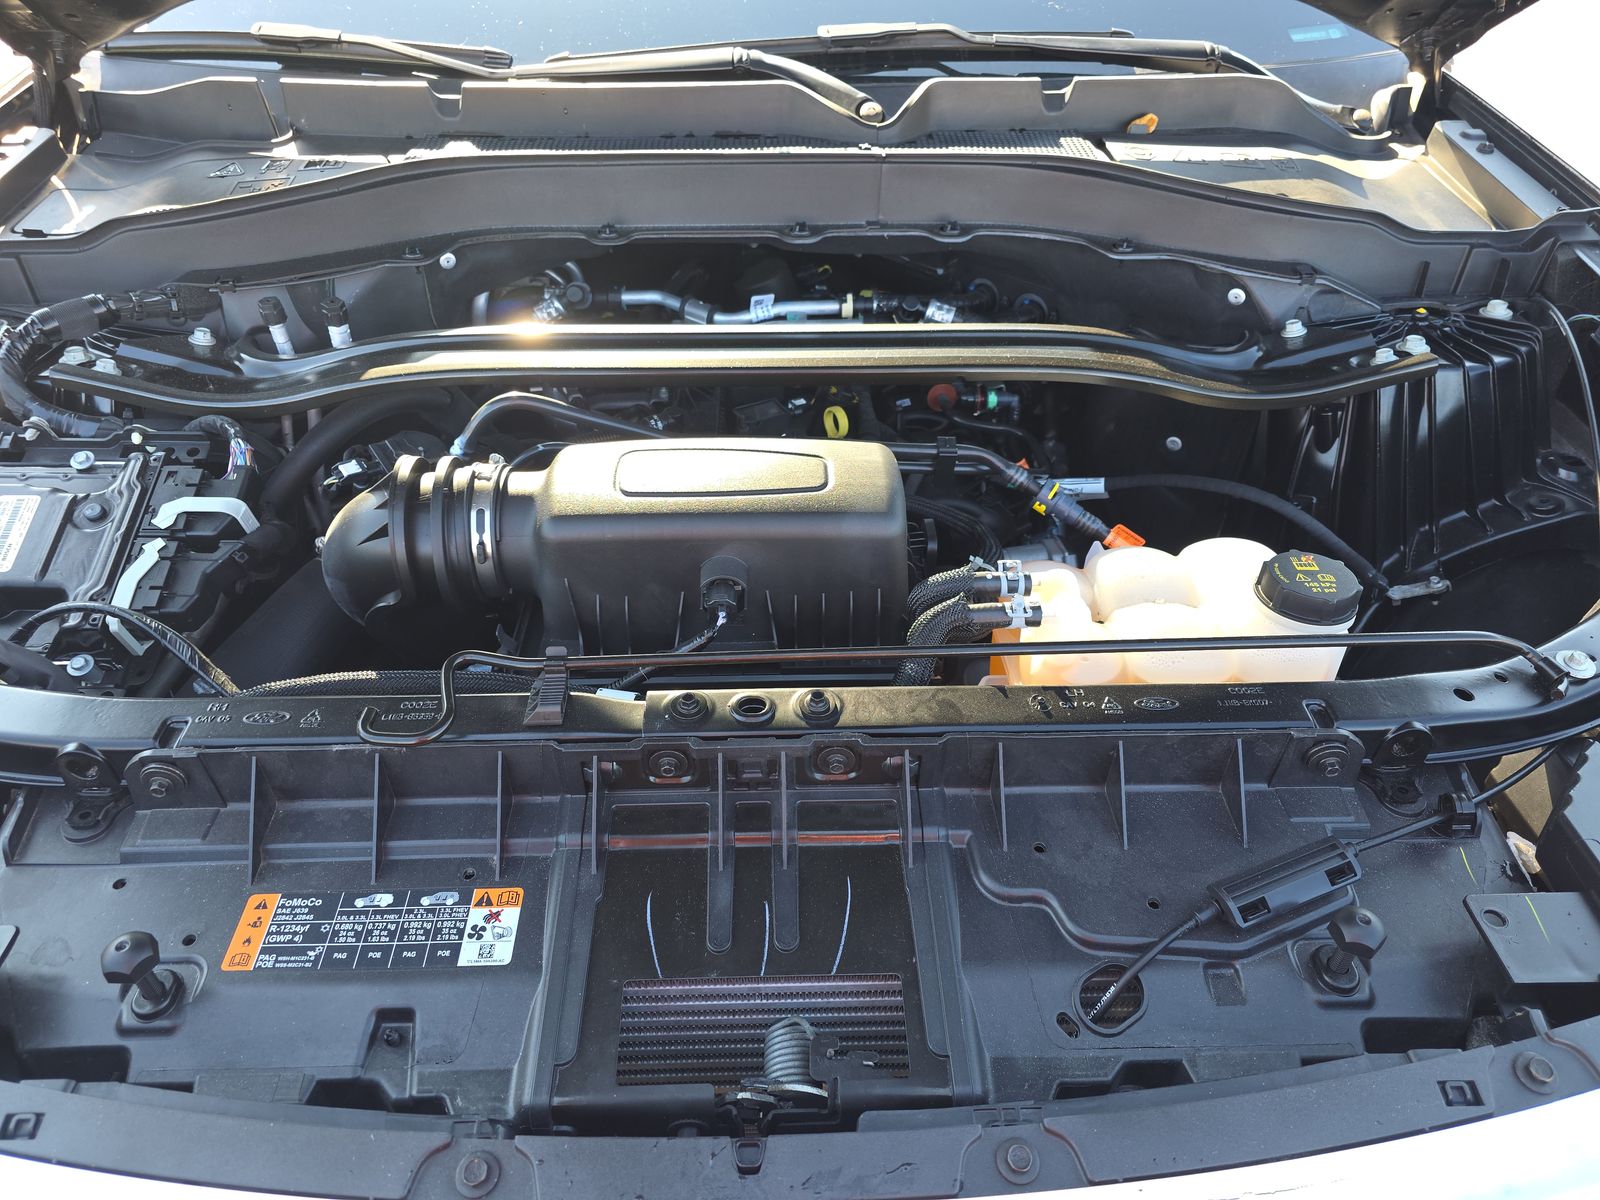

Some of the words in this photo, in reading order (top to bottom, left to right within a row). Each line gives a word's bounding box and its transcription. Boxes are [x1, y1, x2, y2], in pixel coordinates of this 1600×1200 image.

[1065, 688, 1085, 697] LH
[279, 898, 322, 907] FoMoCo
[269, 924, 311, 933] R-1234yf
[353, 923, 363, 931] kg
[367, 922, 387, 930] 0.737
[387, 922, 396, 931] kg
[423, 921, 432, 929] kg
[455, 920, 465, 929] kg
[265, 935, 292, 944] (GWP
[293, 934, 303, 943] 4)
